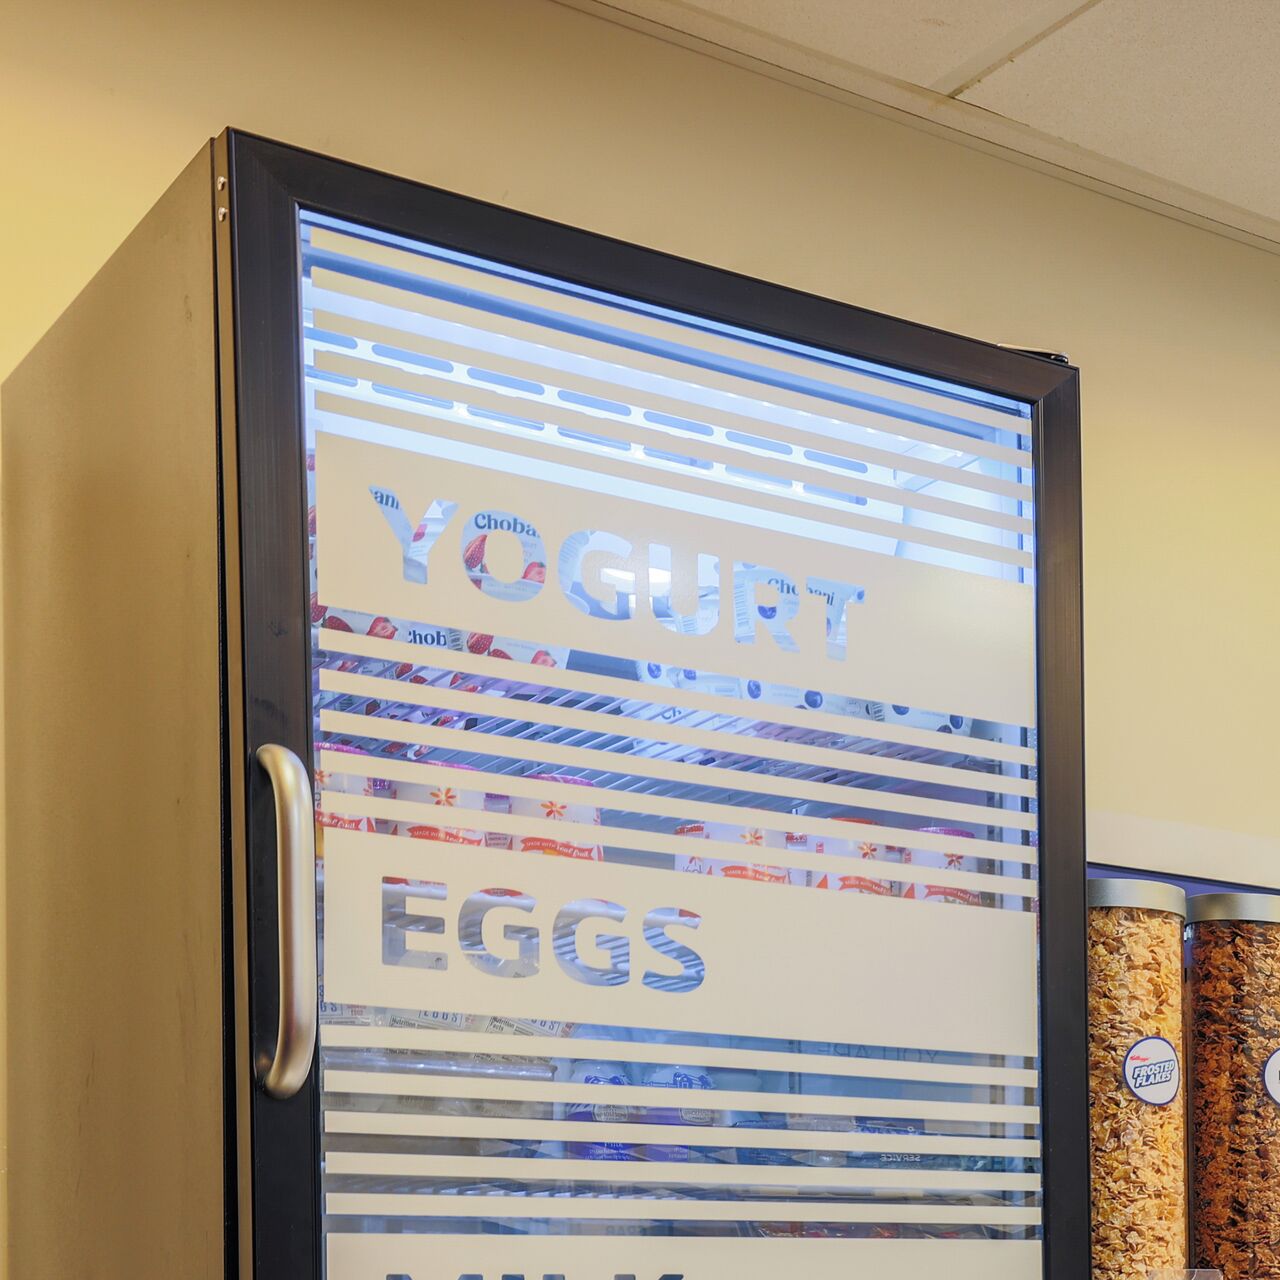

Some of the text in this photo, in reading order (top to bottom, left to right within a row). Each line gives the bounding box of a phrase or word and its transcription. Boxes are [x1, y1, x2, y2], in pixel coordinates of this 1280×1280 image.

[474, 512, 541, 538] Choba
[368, 484, 866, 663] YOGURT
[381, 876, 706, 995] EGGS
[1132, 1059, 1175, 1079] FROSTED
[1134, 1071, 1172, 1088] FLAKES
